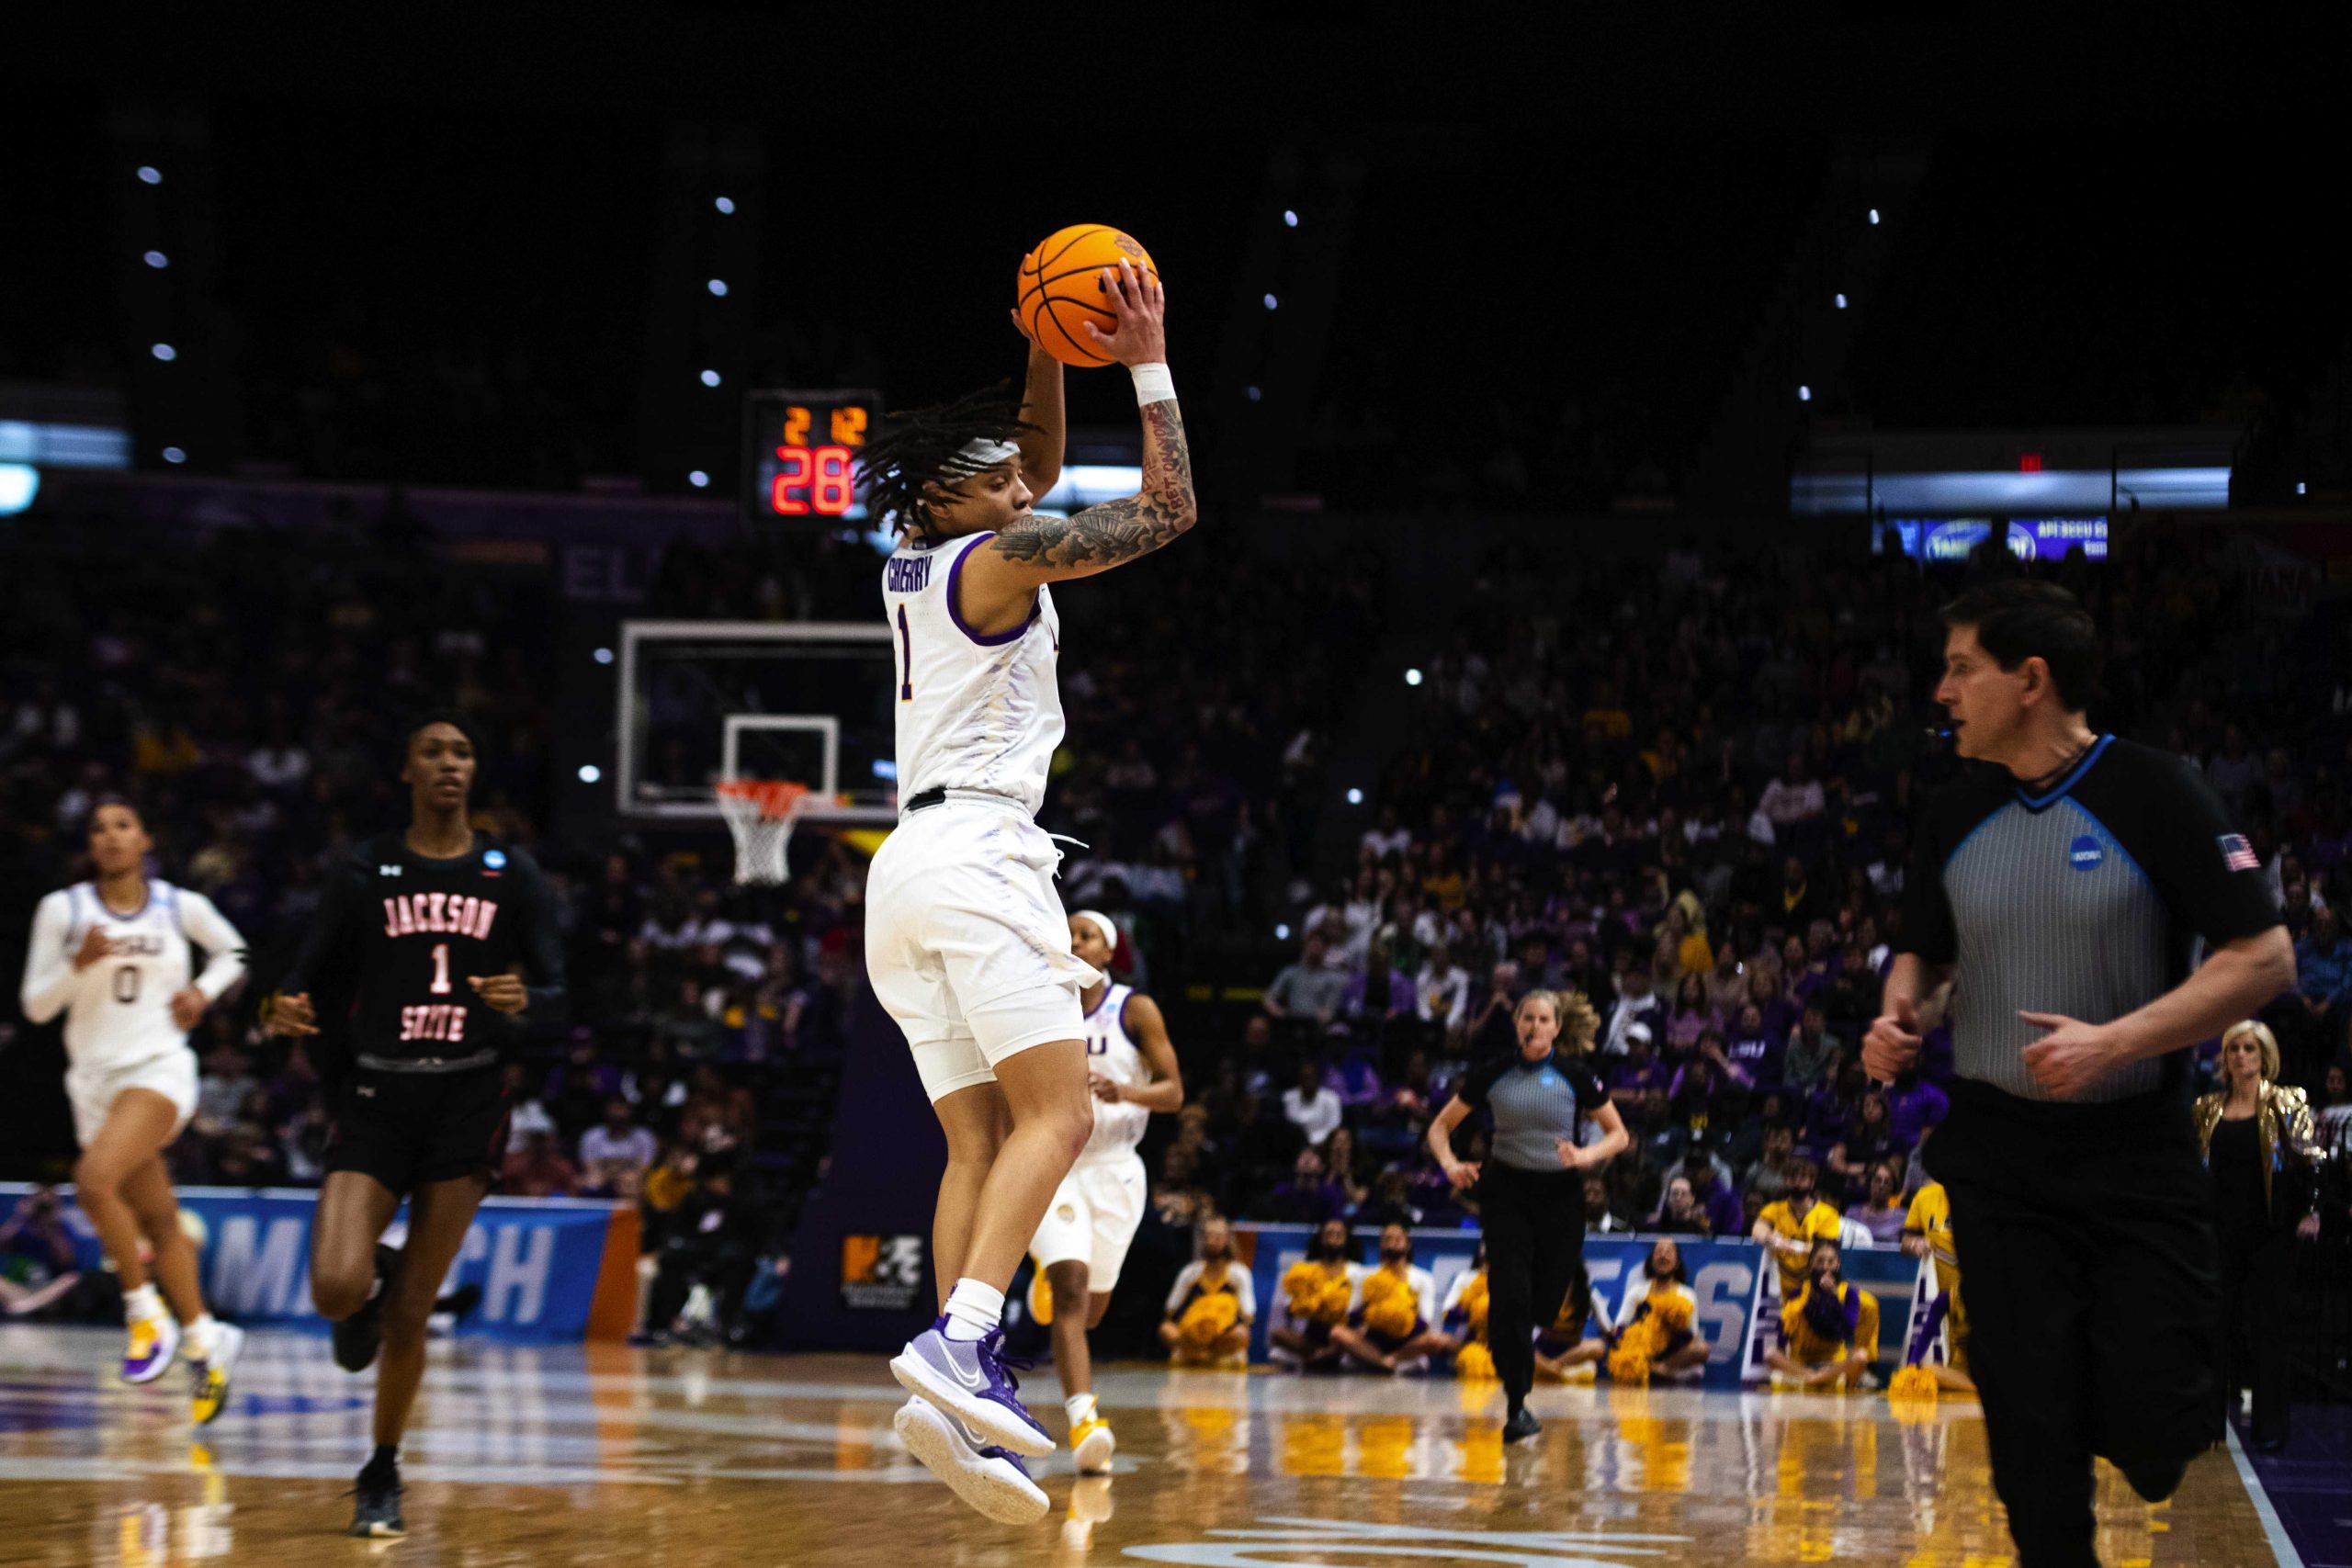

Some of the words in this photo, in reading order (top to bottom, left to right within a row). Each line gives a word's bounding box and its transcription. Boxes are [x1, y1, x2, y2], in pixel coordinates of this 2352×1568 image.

[784, 405, 811, 446] 2
[773, 445, 854, 516] 28
[898, 604, 912, 702] 1
[382, 891, 499, 942] JACKSON
[112, 964, 143, 1005] 0
[429, 942, 453, 994] 1
